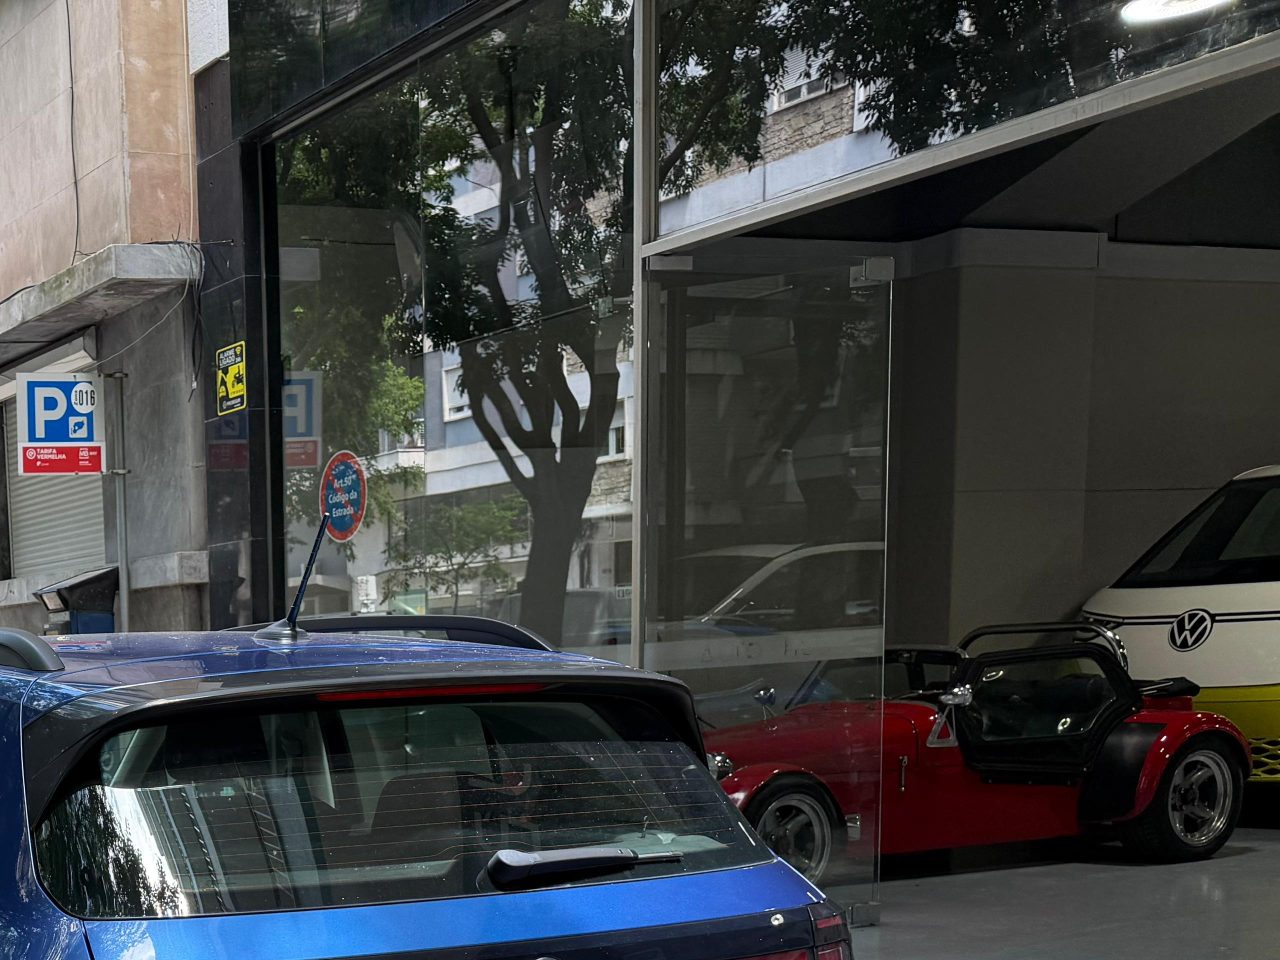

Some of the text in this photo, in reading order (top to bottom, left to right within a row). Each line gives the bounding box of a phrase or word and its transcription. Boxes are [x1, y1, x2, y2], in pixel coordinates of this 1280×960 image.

[78, 389, 96, 406] 016
[34, 386, 68, 438] P
[328, 489, 358, 504] Código da
[332, 504, 354, 517] Estrada
